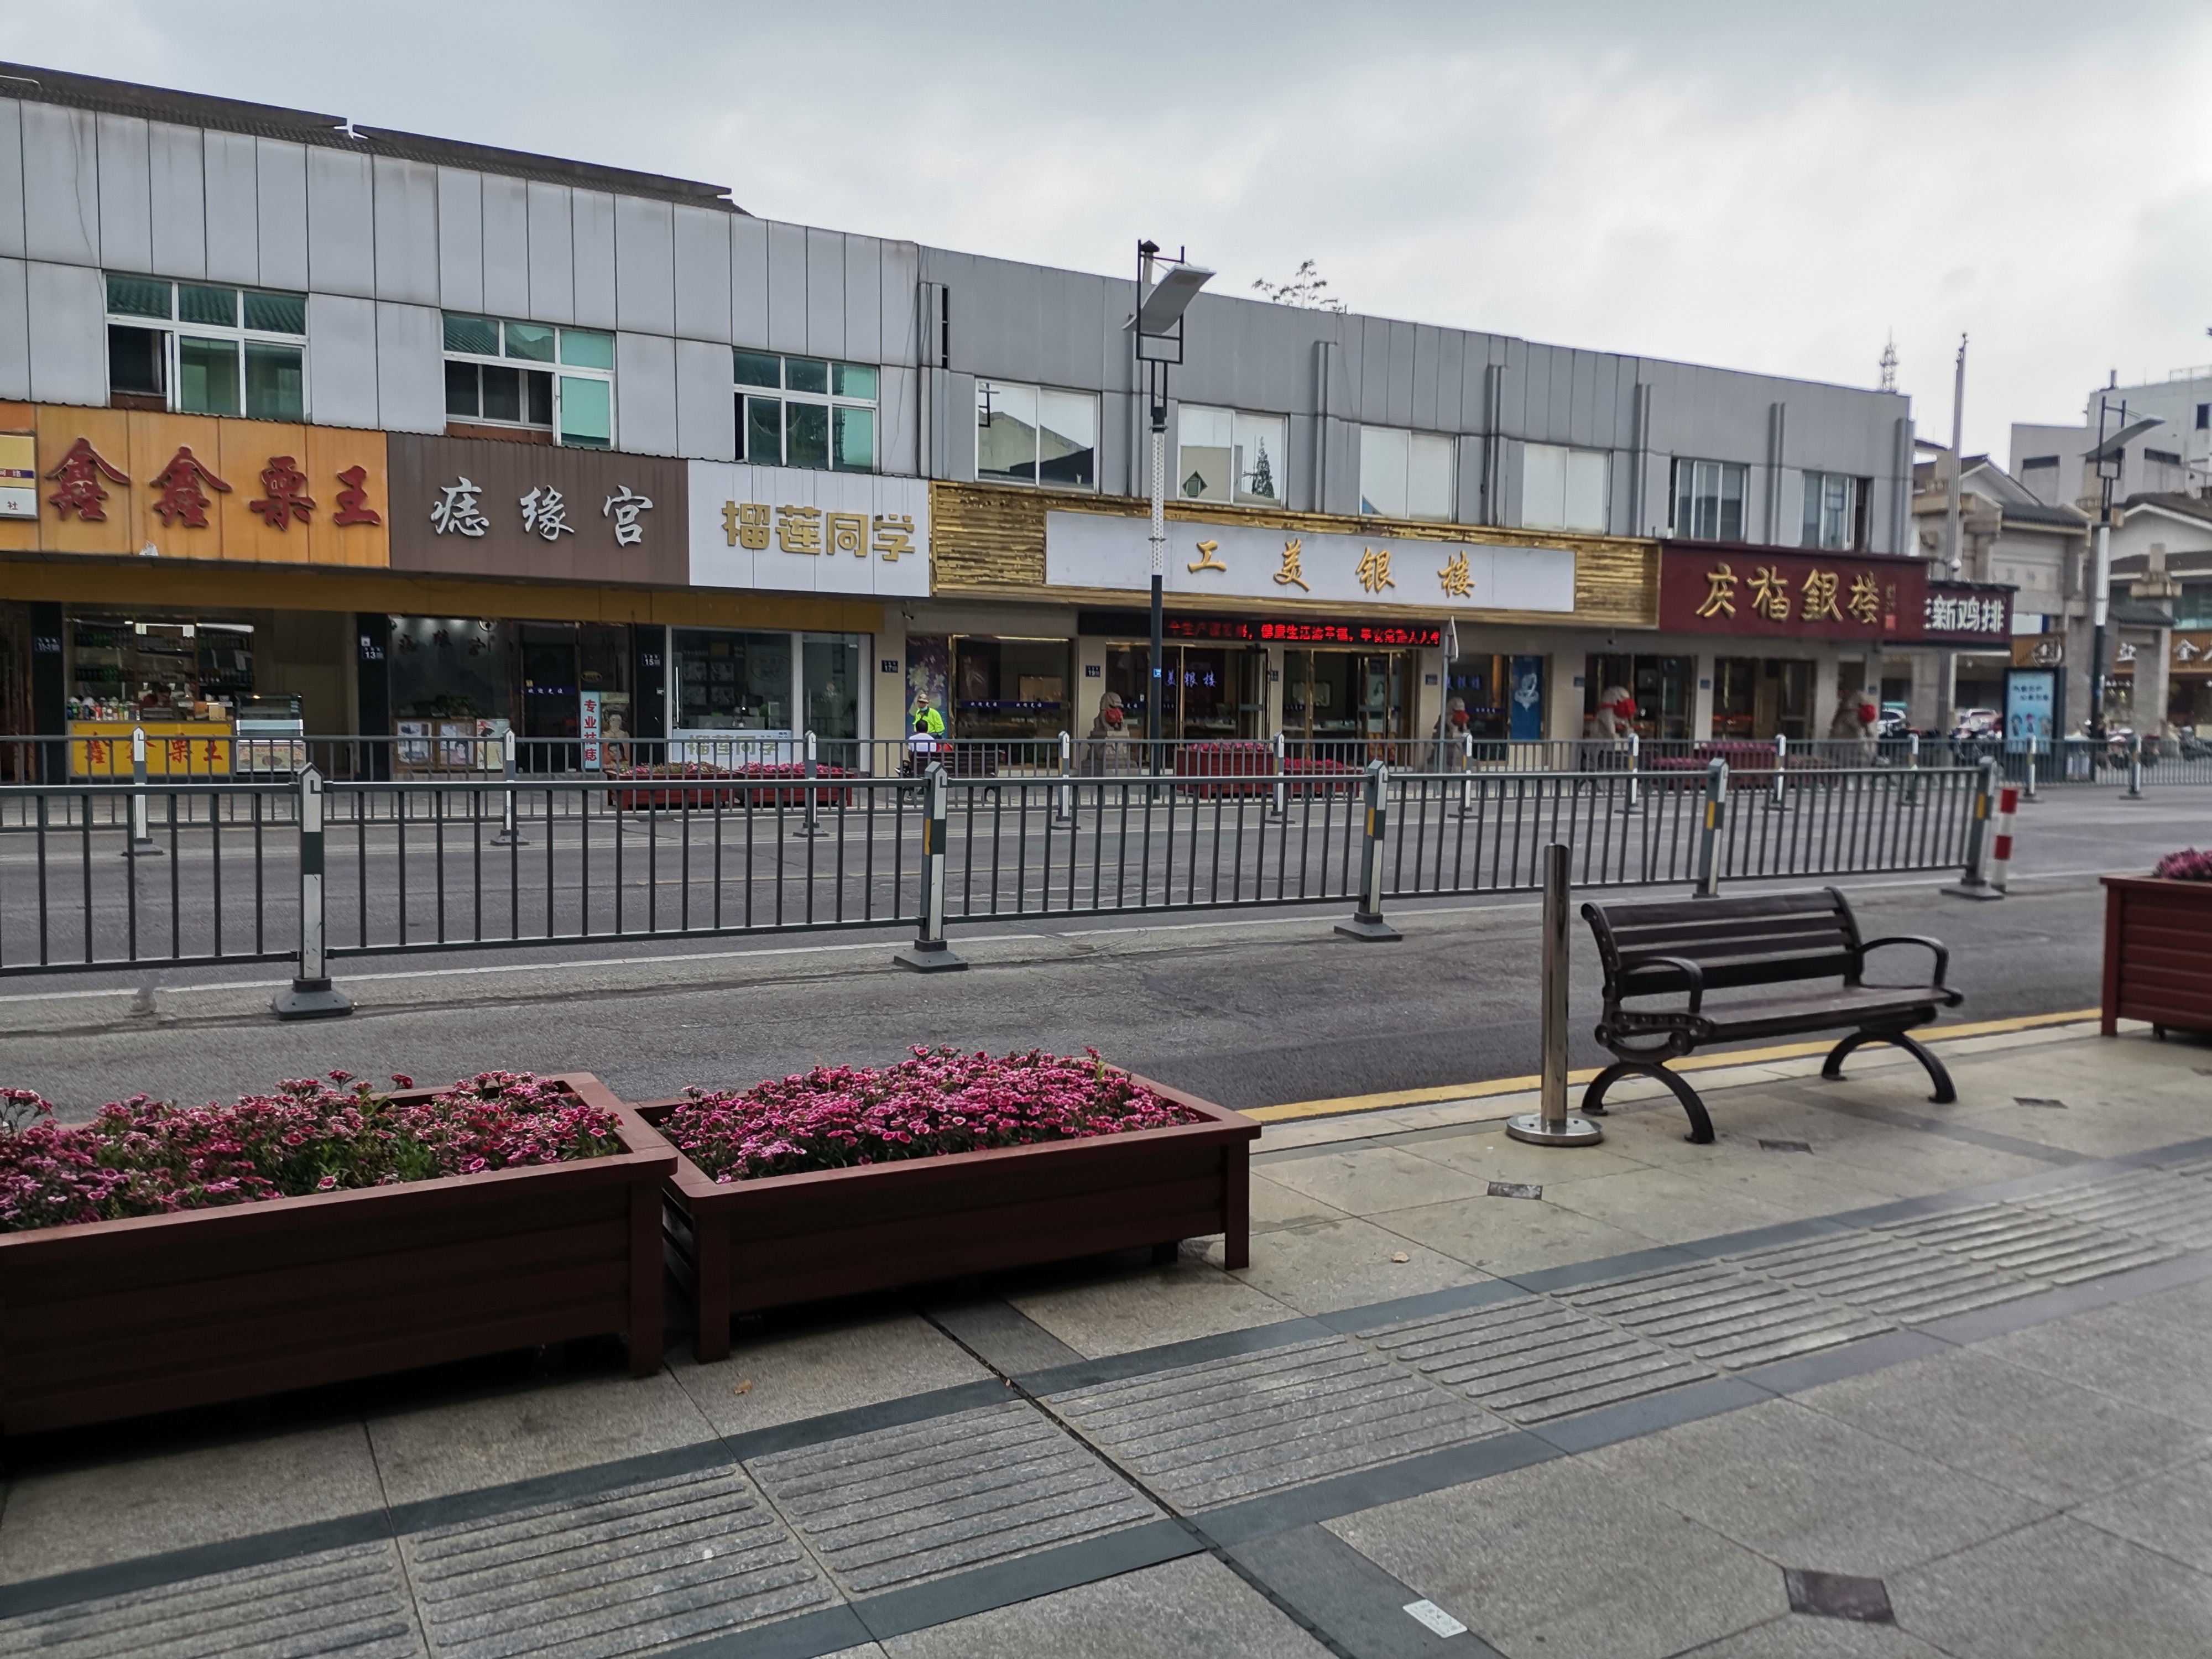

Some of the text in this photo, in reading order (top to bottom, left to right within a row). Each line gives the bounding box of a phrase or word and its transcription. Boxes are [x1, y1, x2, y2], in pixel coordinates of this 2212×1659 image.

[430, 476, 654, 547] 痣缘宫
[721, 500, 915, 561] 榴莲同学
[1187, 538, 1475, 598] 工美银楼
[1923, 594, 2005, 633] 新鸡排
[84, 731, 223, 764] 鑫栗王
